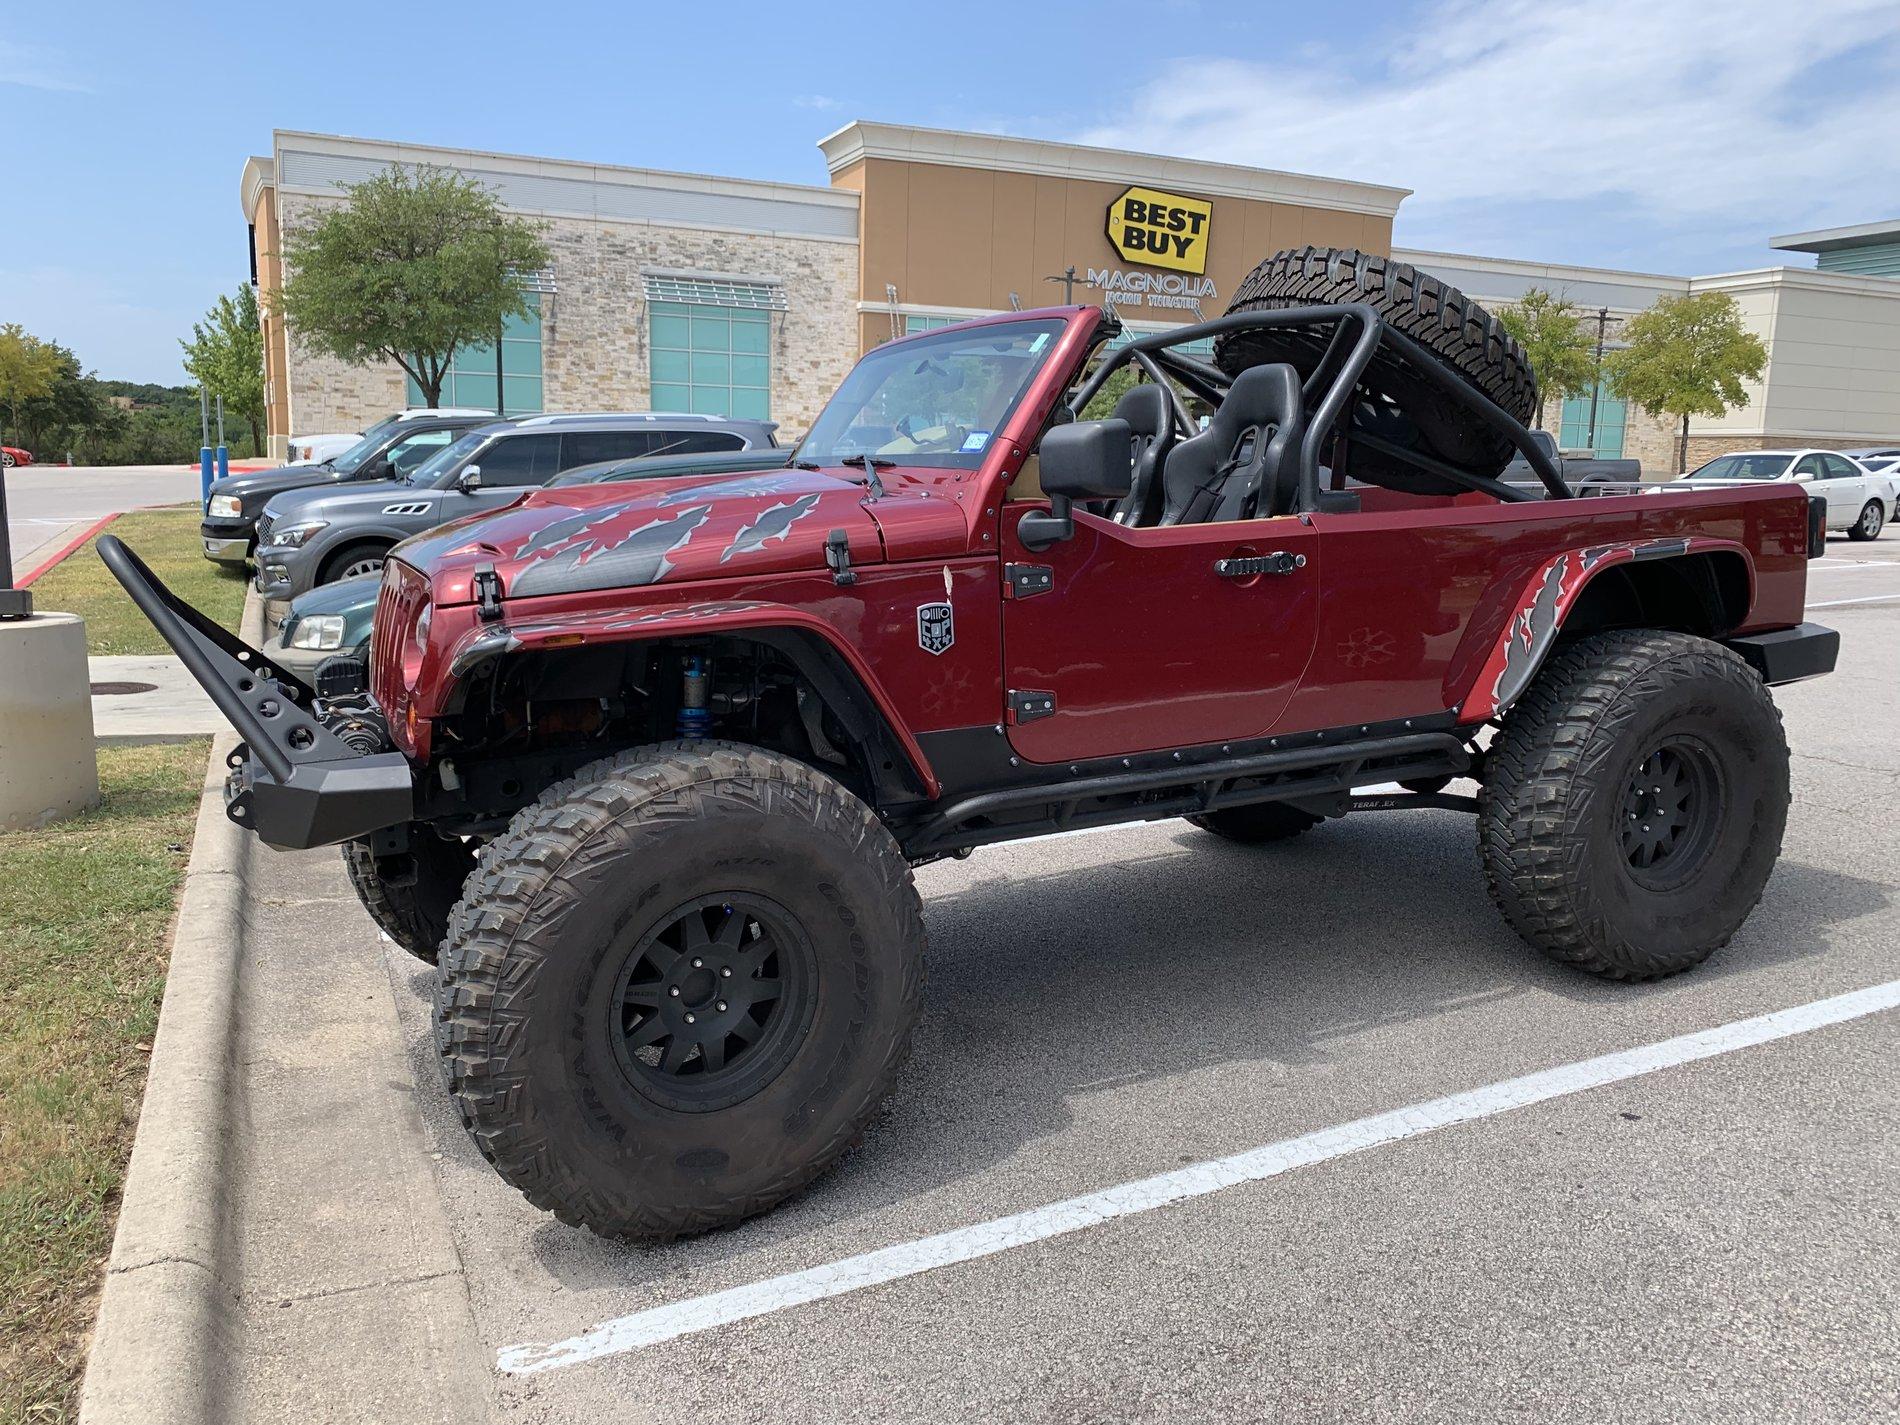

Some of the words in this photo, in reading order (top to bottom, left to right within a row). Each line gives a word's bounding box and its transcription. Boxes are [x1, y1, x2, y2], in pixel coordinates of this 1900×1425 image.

[1124, 198, 1207, 235] BEST
[1122, 225, 1195, 259] BUY
[1086, 268, 1217, 298] MAGNOLIA
[1105, 291, 1142, 305] HOME
